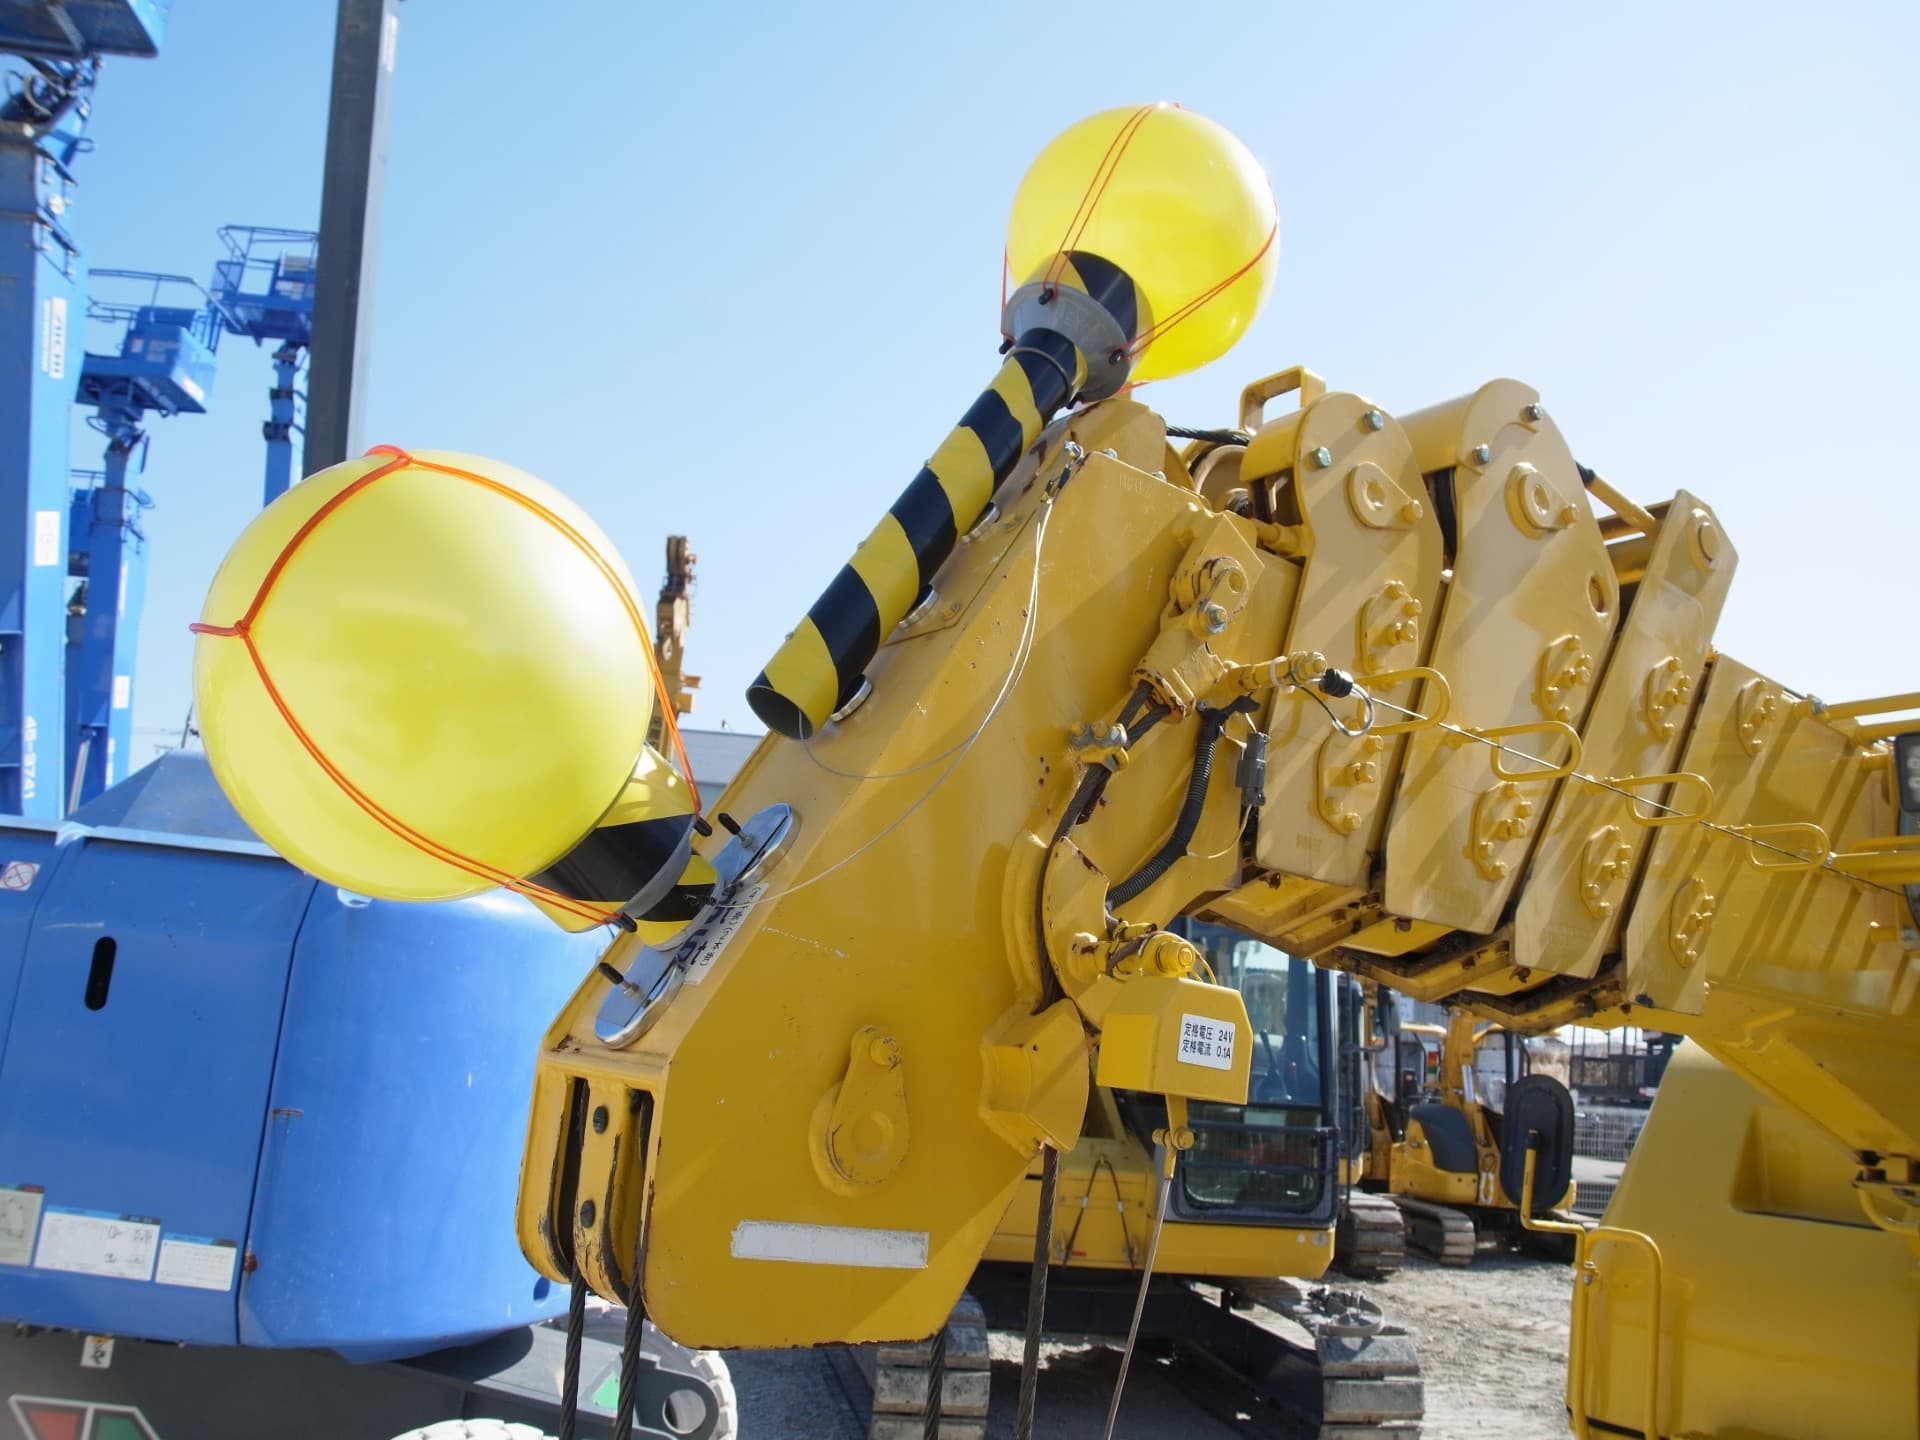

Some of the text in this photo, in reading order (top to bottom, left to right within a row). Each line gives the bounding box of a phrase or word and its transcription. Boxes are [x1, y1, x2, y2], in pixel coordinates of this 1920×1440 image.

[1184, 1022, 1233, 1043] 定格電圧 24V
[1182, 1039, 1231, 1060] 定格電流 0.1A
